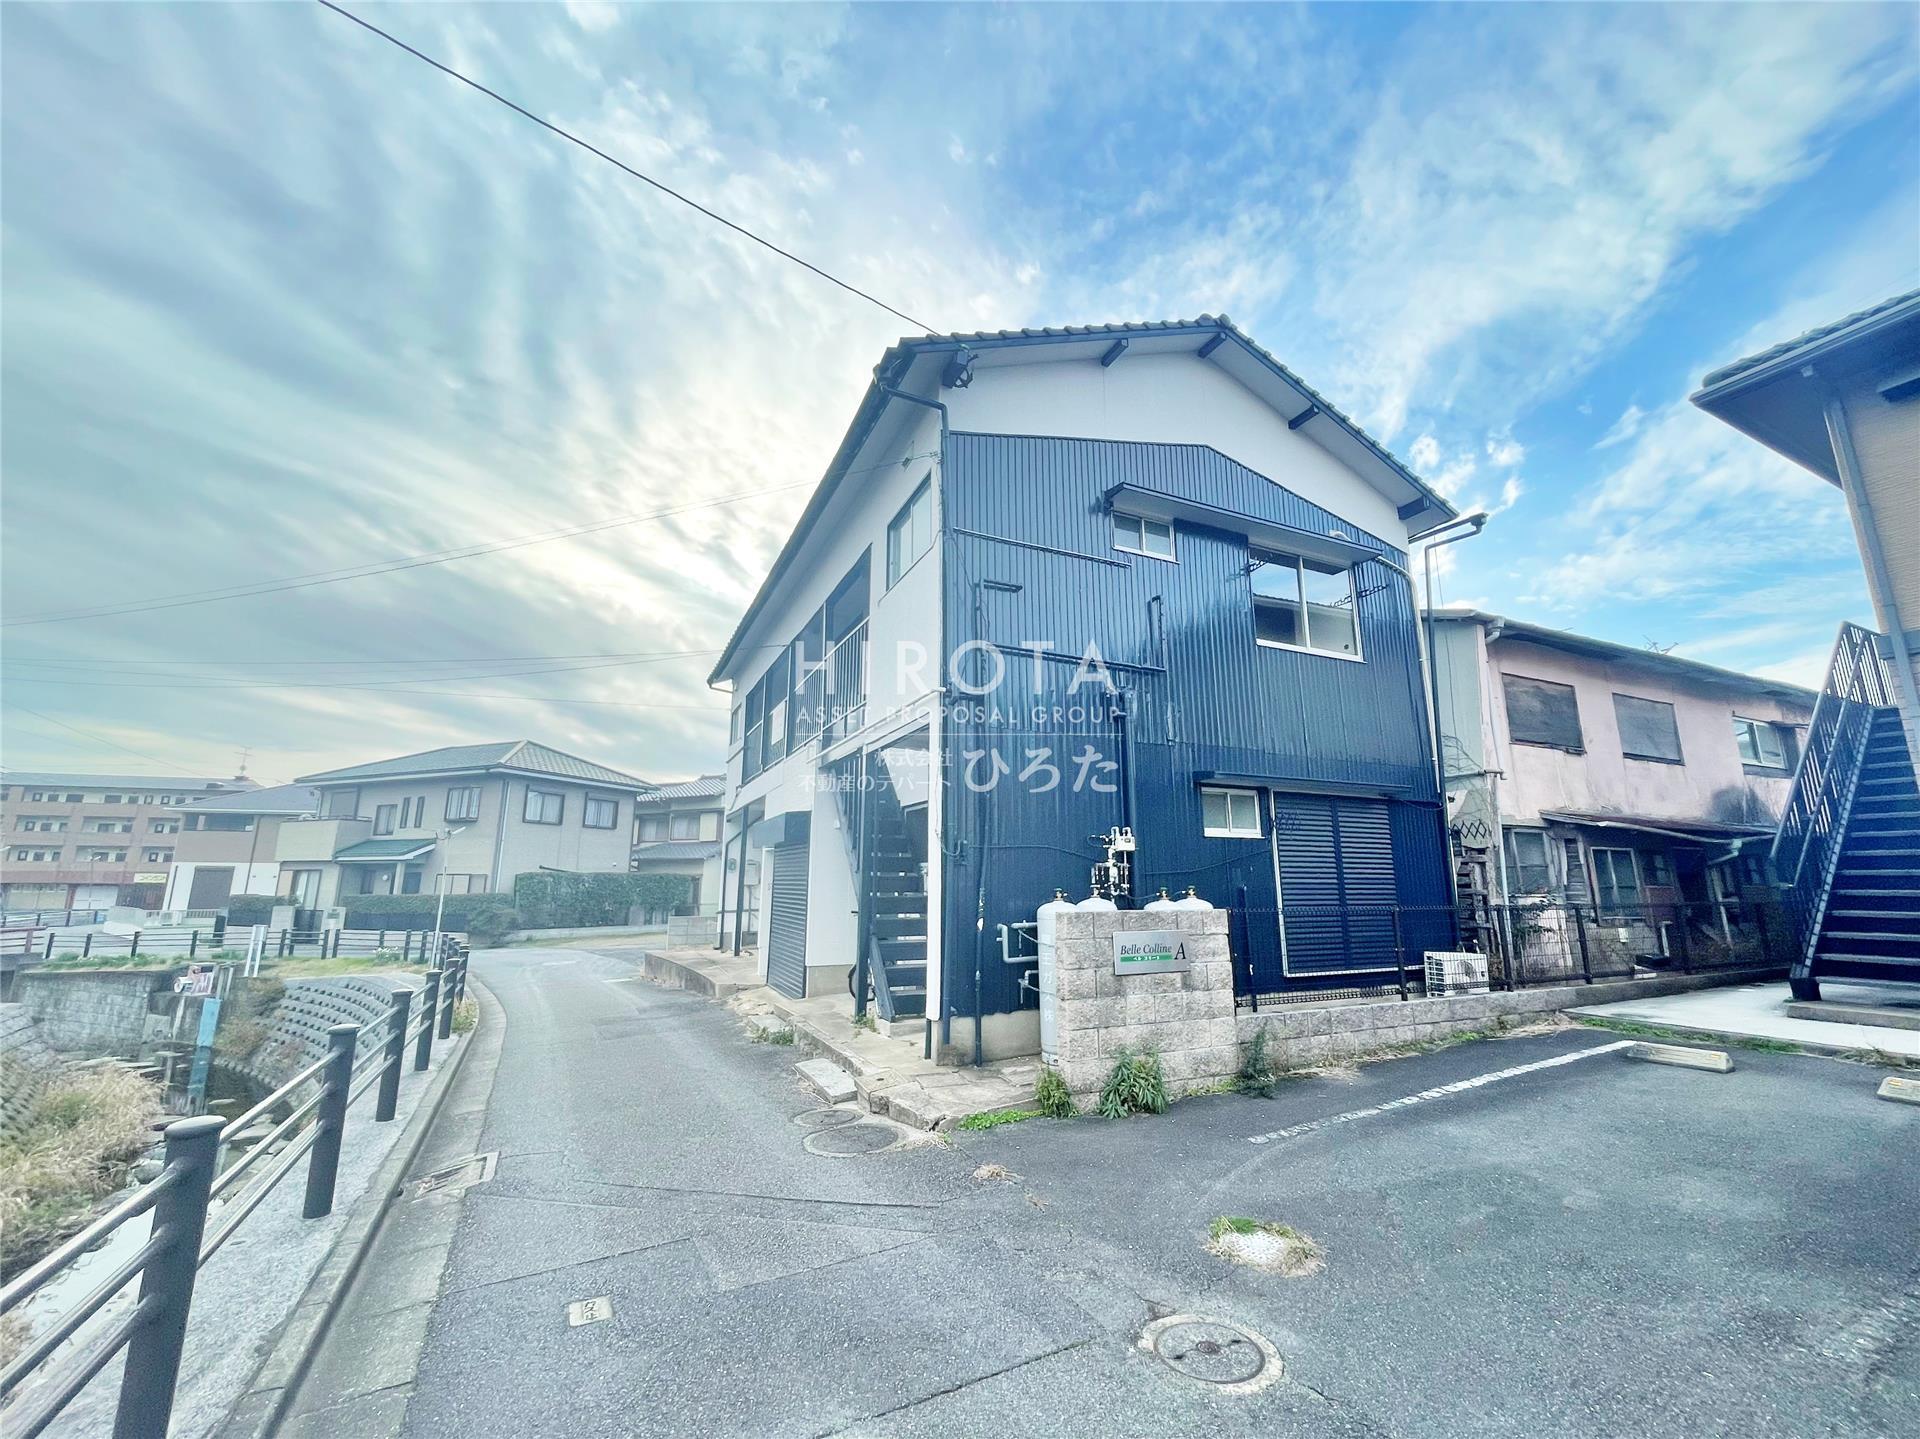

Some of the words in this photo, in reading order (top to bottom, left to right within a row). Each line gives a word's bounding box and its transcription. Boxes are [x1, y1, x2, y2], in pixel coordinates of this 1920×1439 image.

[1120, 944, 1141, 955] Belle
[1143, 943, 1172, 954] Colline
[1174, 942, 1186, 960] A
